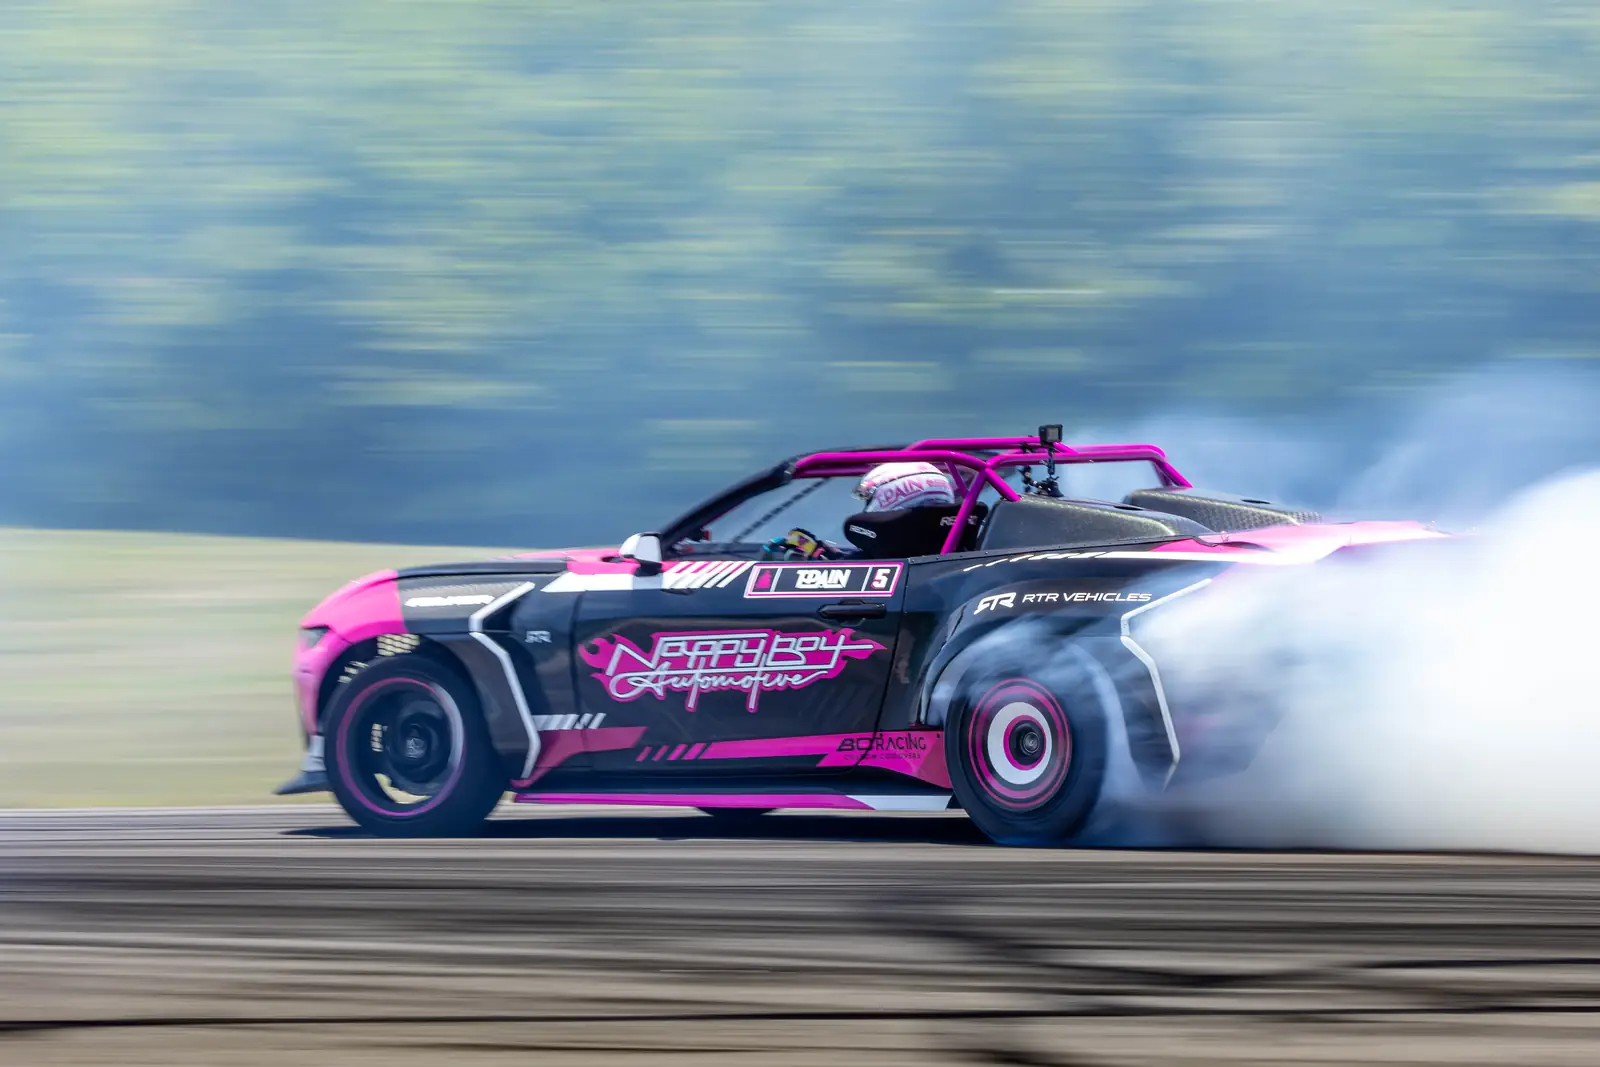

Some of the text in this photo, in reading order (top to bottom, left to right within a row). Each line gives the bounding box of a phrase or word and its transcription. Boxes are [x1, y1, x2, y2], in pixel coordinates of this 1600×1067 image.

[871, 568, 890, 588] 5
[1022, 592, 1152, 603] RTR VEHICLES
[875, 732, 927, 751] RACING
